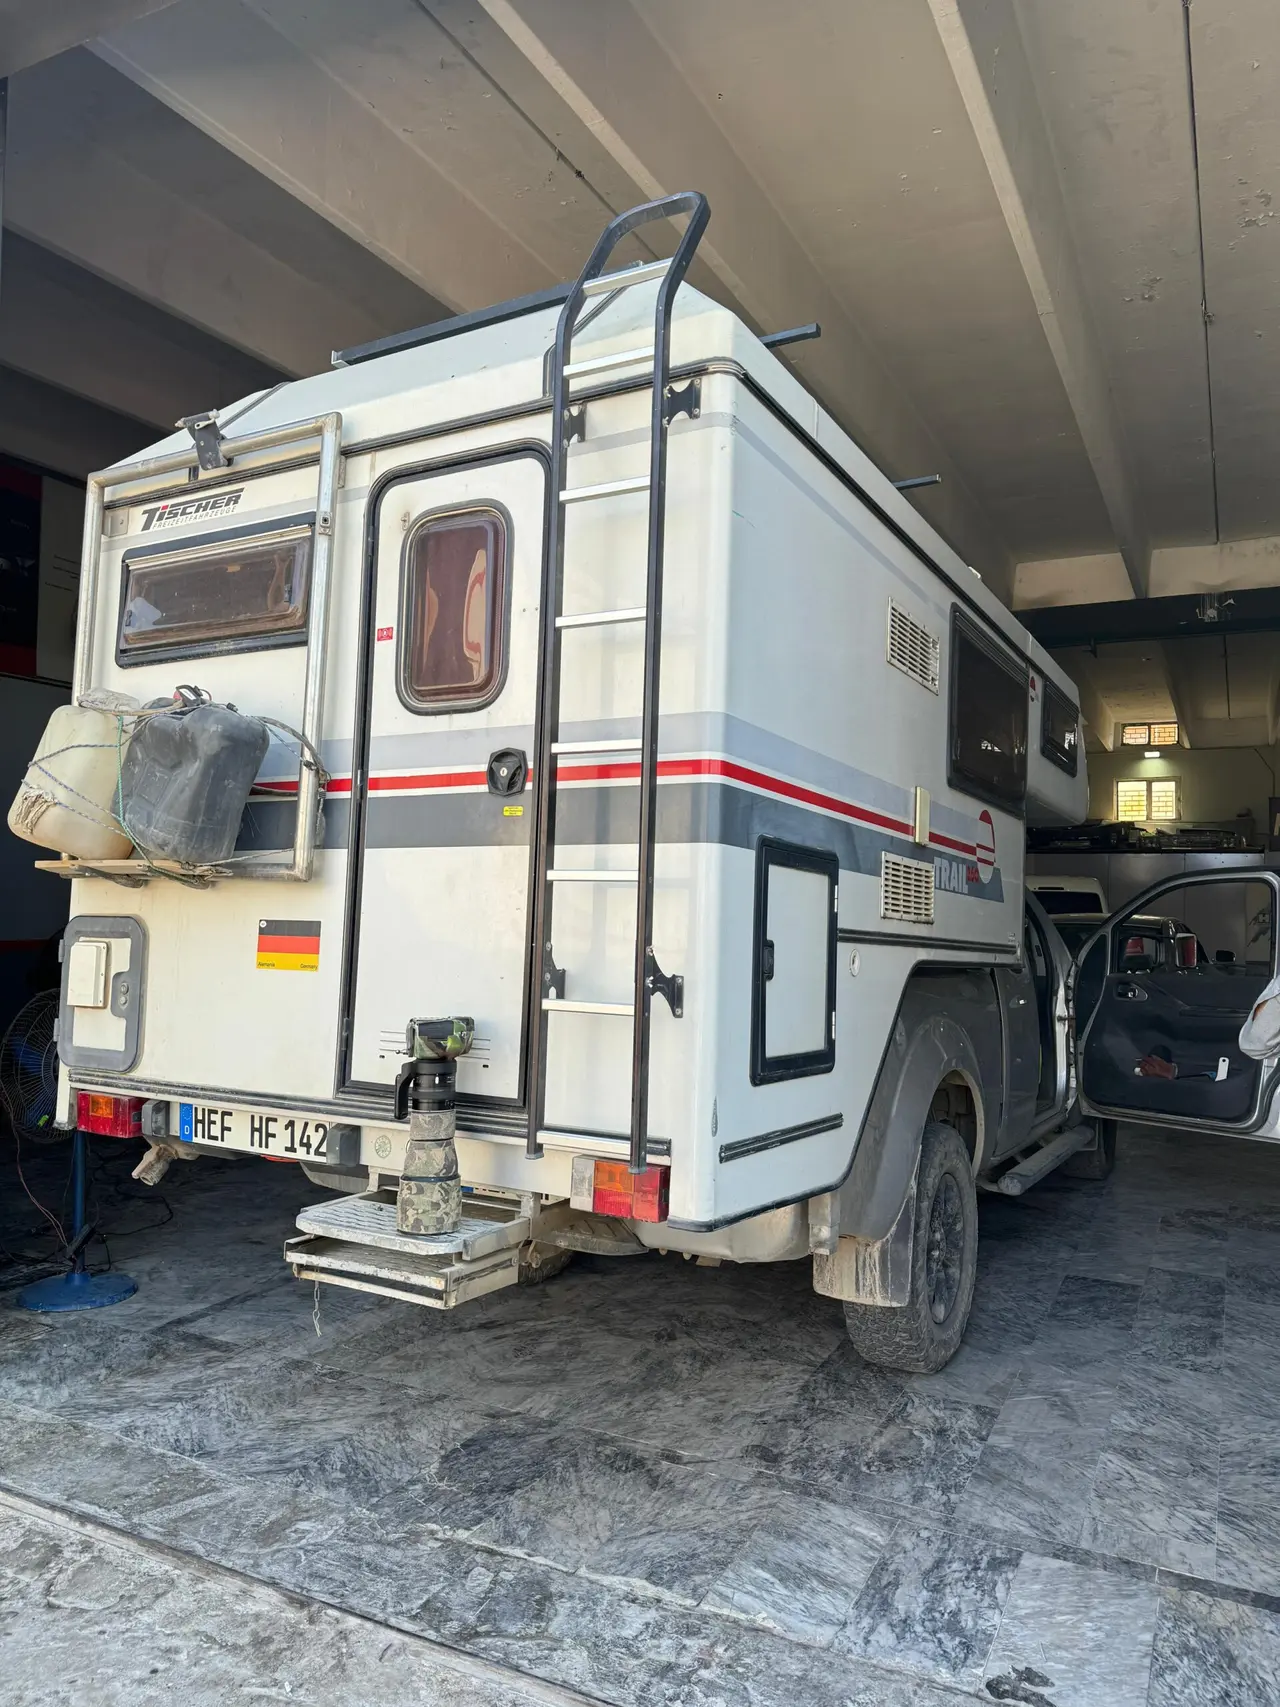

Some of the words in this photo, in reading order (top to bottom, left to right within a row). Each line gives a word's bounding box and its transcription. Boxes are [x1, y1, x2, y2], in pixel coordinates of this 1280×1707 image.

[153, 505, 236, 529] FREIZEITFAHRZEUGE
[934, 856, 968, 894] TRAIL
[184, 1125, 190, 1135] D
[193, 1106, 233, 1142] HEF
[250, 1114, 278, 1149] HF
[284, 1119, 327, 1155] 142
